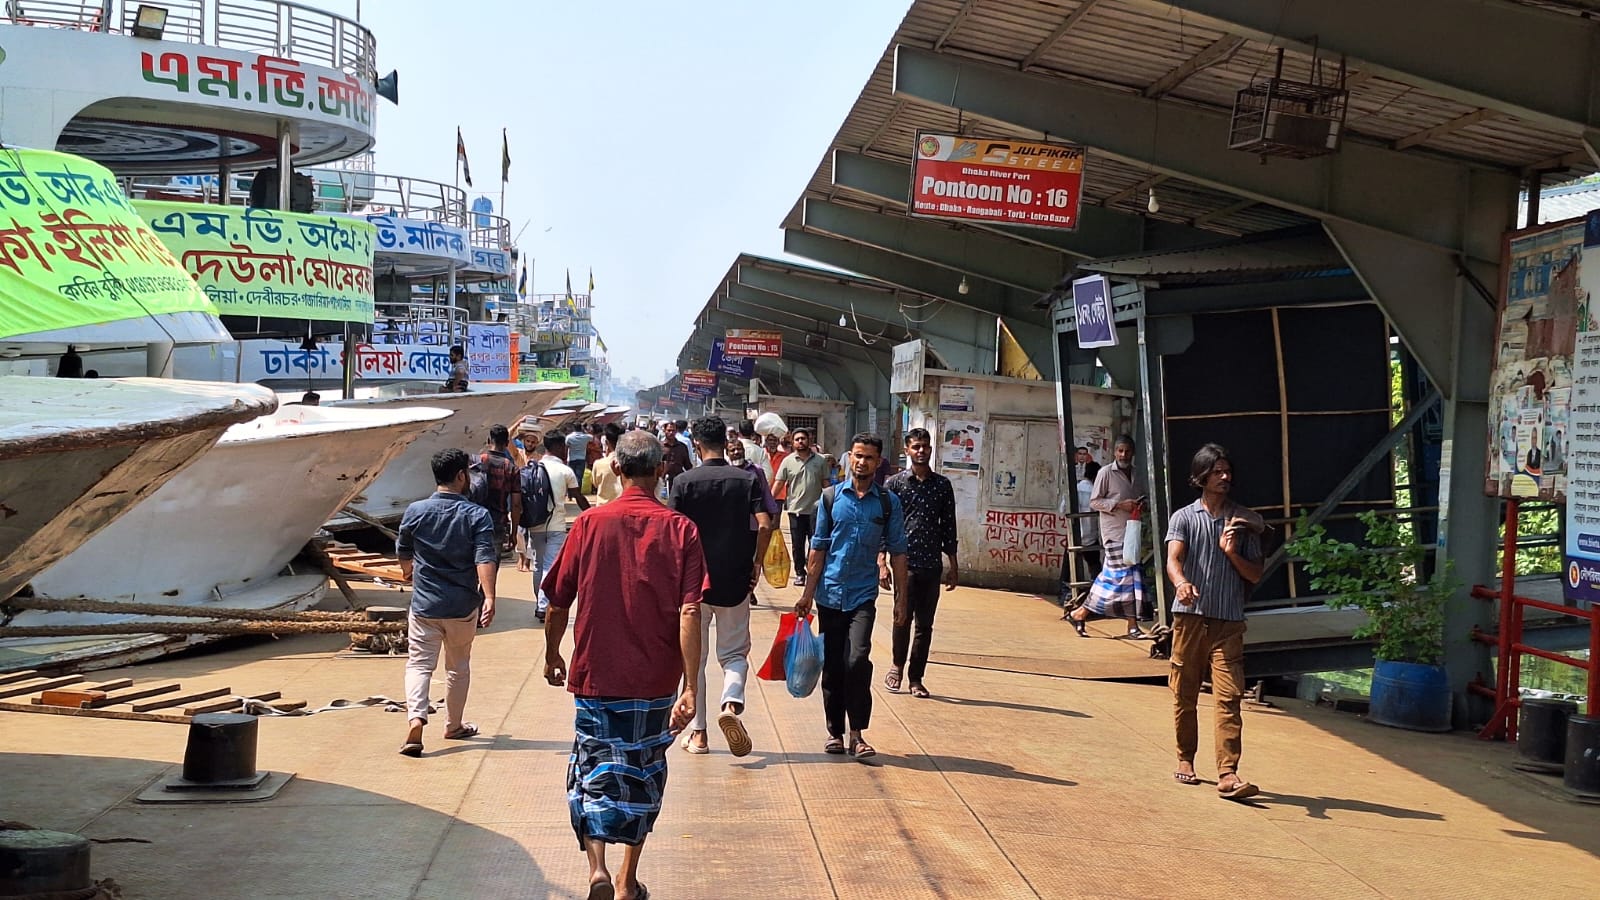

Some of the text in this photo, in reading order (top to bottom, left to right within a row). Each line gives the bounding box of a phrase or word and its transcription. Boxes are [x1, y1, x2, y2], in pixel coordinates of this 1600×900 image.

[1012, 146, 1080, 160] JULFIKAR
[1008, 156, 1077, 171] STEEL
[962, 167, 1031, 181] Dhaka River Port
[921, 176, 1003, 202] Pontoon
[1006, 184, 1033, 205] No
[1045, 188, 1068, 208] 16
